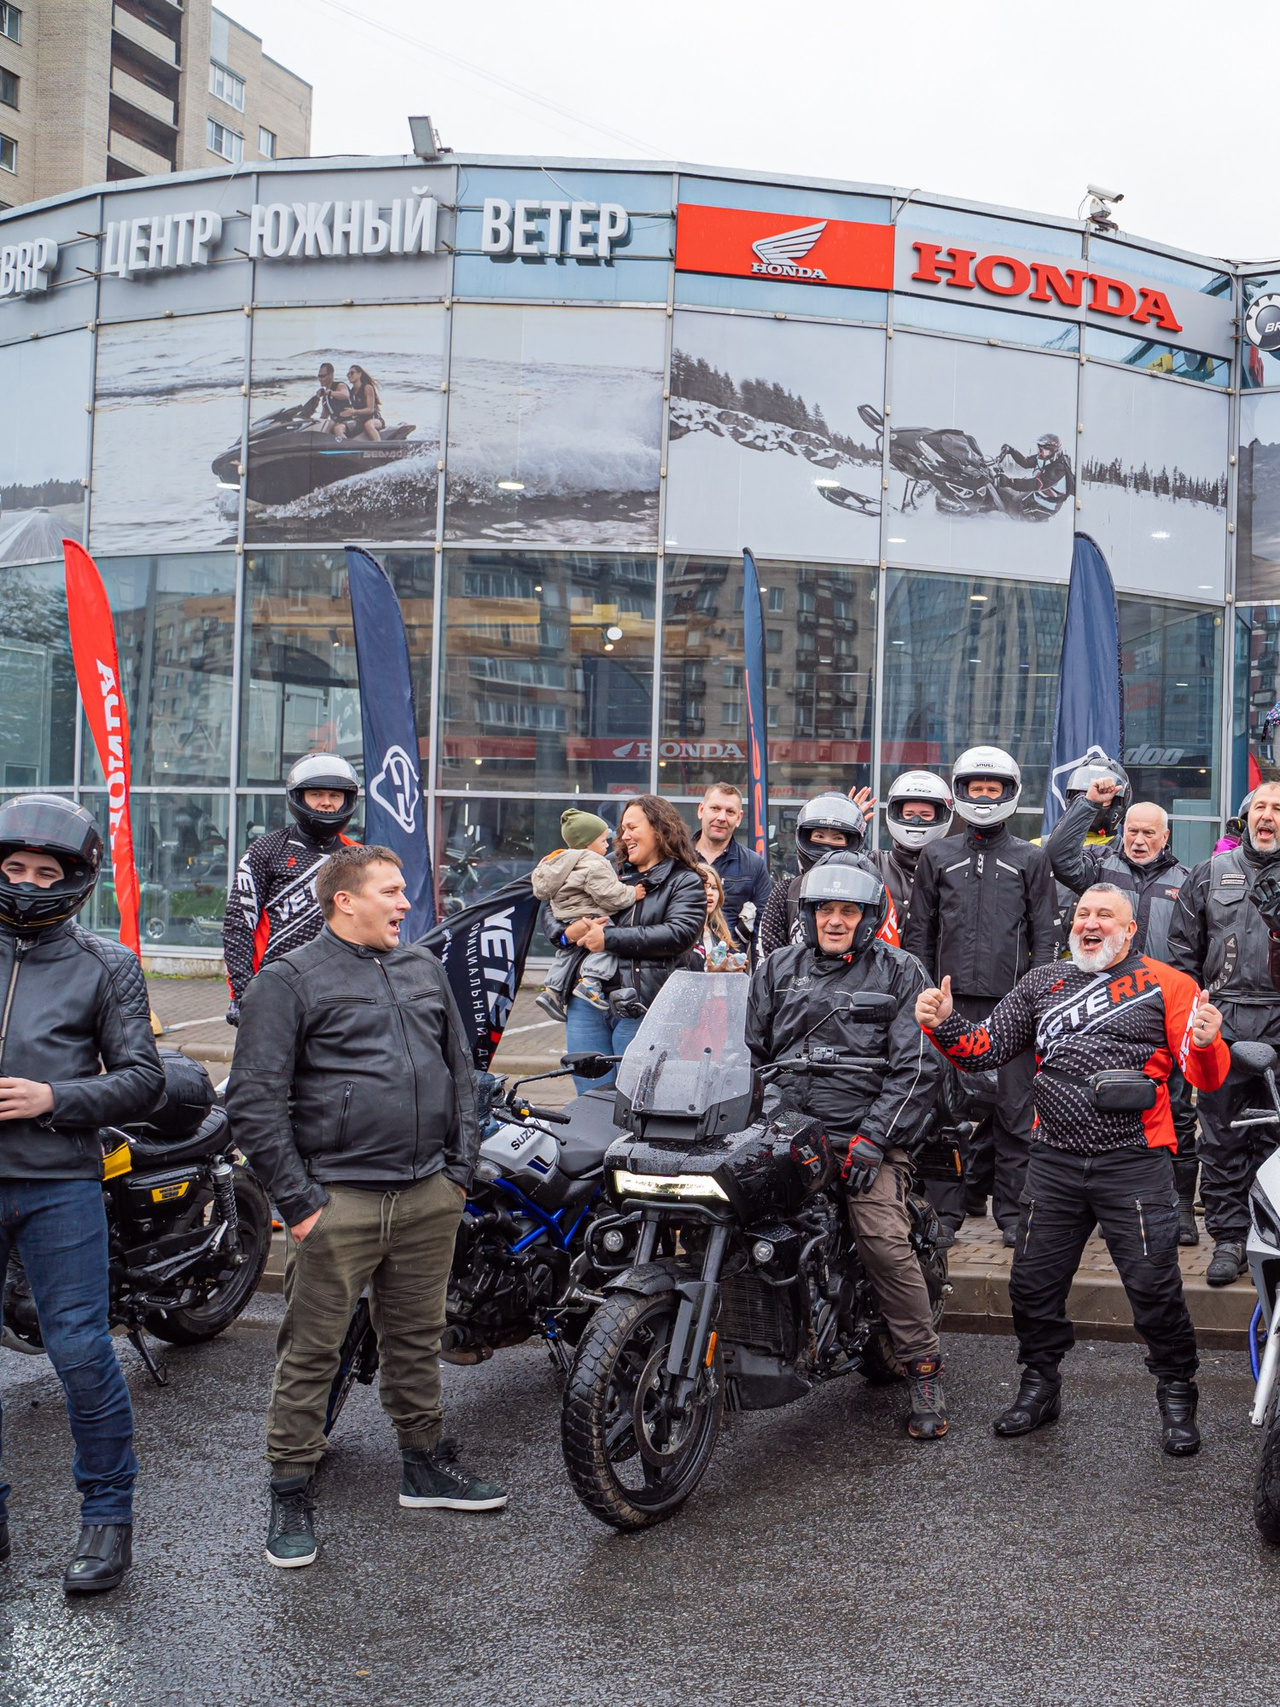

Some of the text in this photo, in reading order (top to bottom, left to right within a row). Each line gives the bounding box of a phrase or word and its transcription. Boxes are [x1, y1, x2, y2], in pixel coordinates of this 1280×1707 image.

[103, 210, 222, 280] ЦЕНТР
[248, 185, 439, 261] ЮЖНЫЙ
[481, 198, 629, 263] ВЕТЕР
[751, 261, 828, 281] HONDA
[911, 241, 1184, 333] HONDA
[819, 819, 842, 827] SHARK
